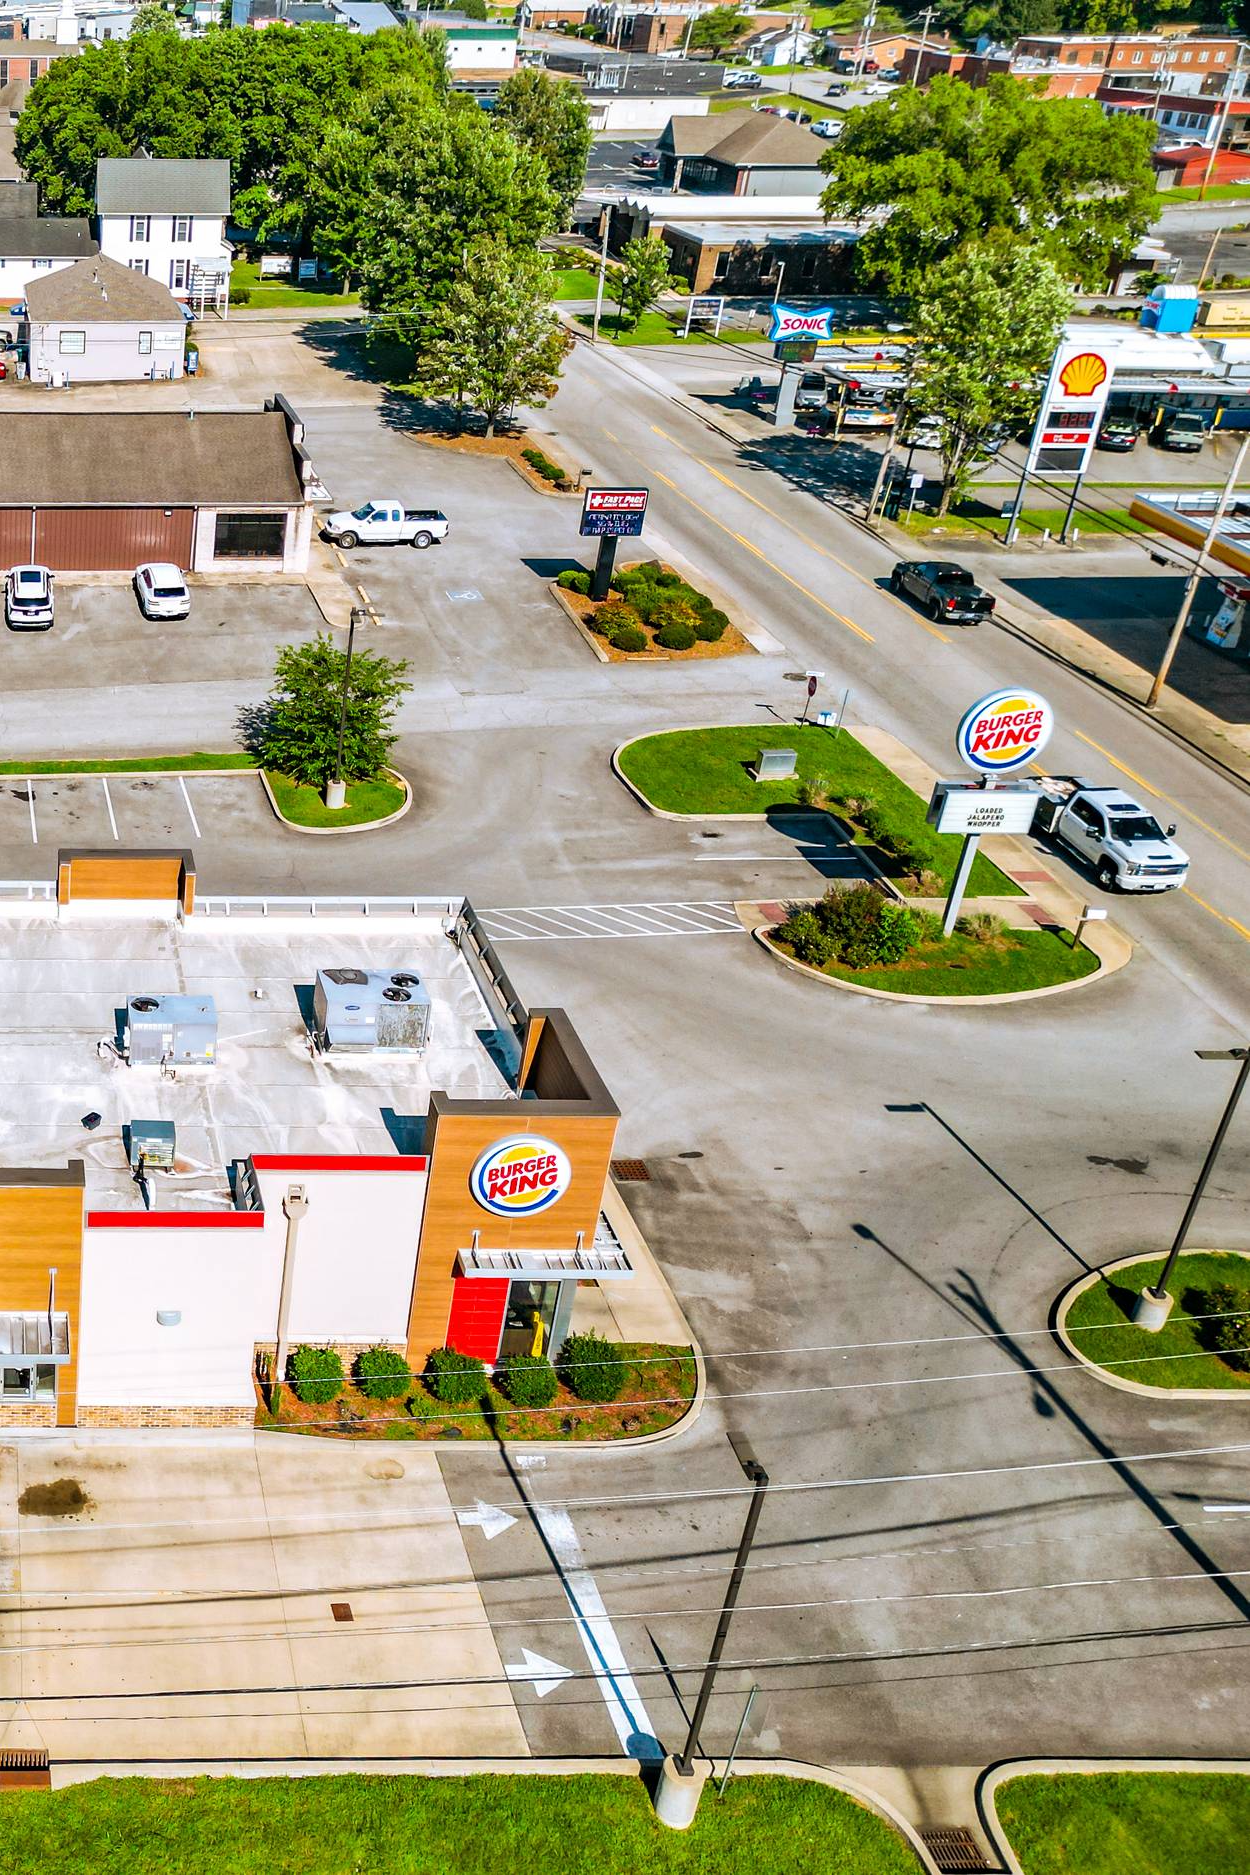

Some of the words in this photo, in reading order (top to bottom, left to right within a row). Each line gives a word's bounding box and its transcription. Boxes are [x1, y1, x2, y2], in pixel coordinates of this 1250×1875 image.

[780, 318, 827, 330] SONIC
[603, 495, 624, 504] FAST
[624, 495, 645, 504] PACE
[975, 710, 1044, 734] BURGER
[971, 724, 1042, 753] KING
[487, 1155, 557, 1182] BURGER
[488, 1167, 558, 1200] KING
